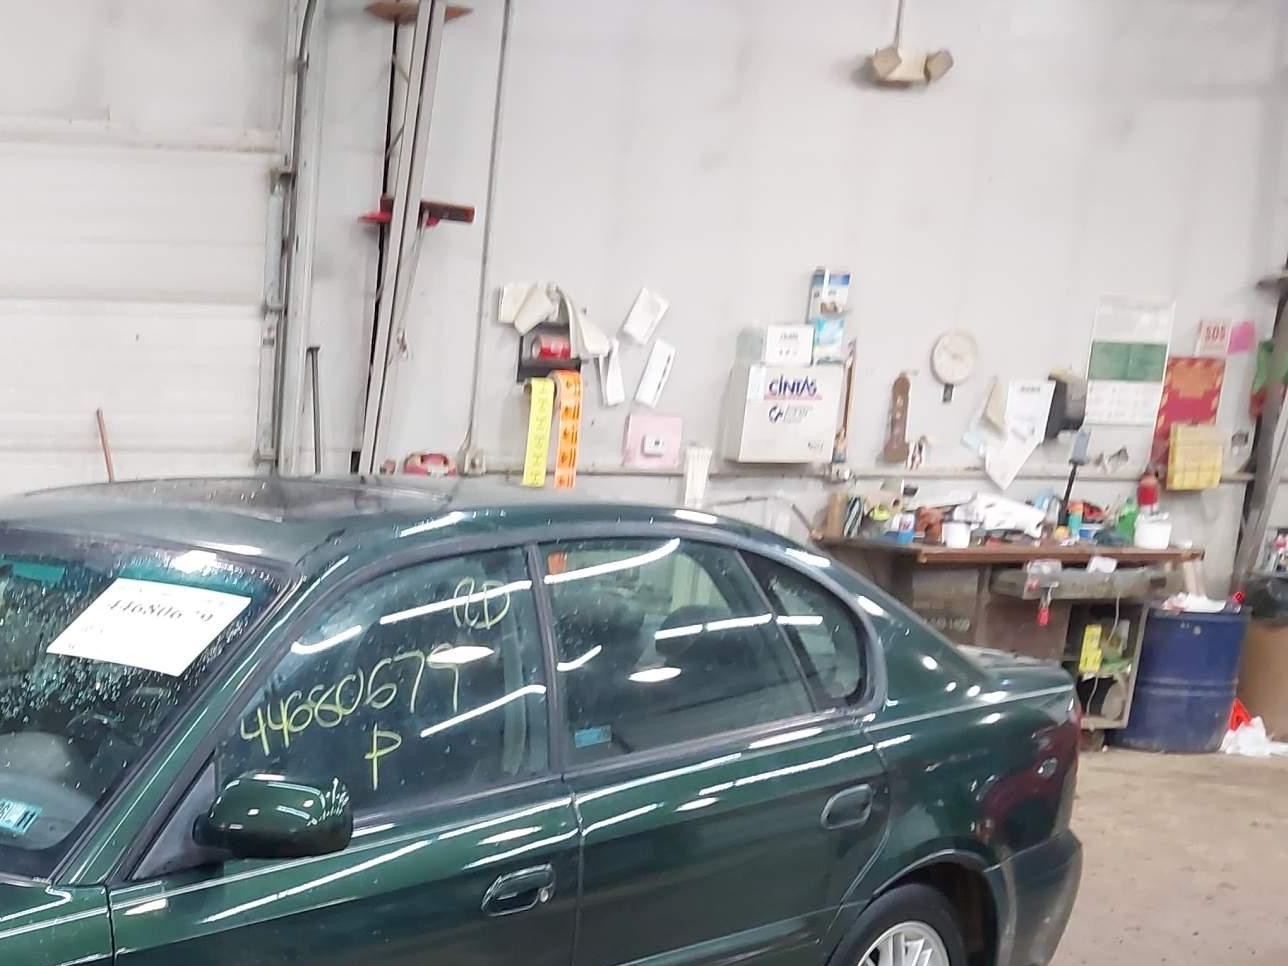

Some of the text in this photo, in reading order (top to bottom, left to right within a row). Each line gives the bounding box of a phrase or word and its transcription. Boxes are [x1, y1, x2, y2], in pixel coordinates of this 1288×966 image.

[768, 373, 817, 397] CINTAS
[108, 599, 214, 623] 4468069
[240, 642, 460, 756] 44680679
[364, 722, 403, 791] P
